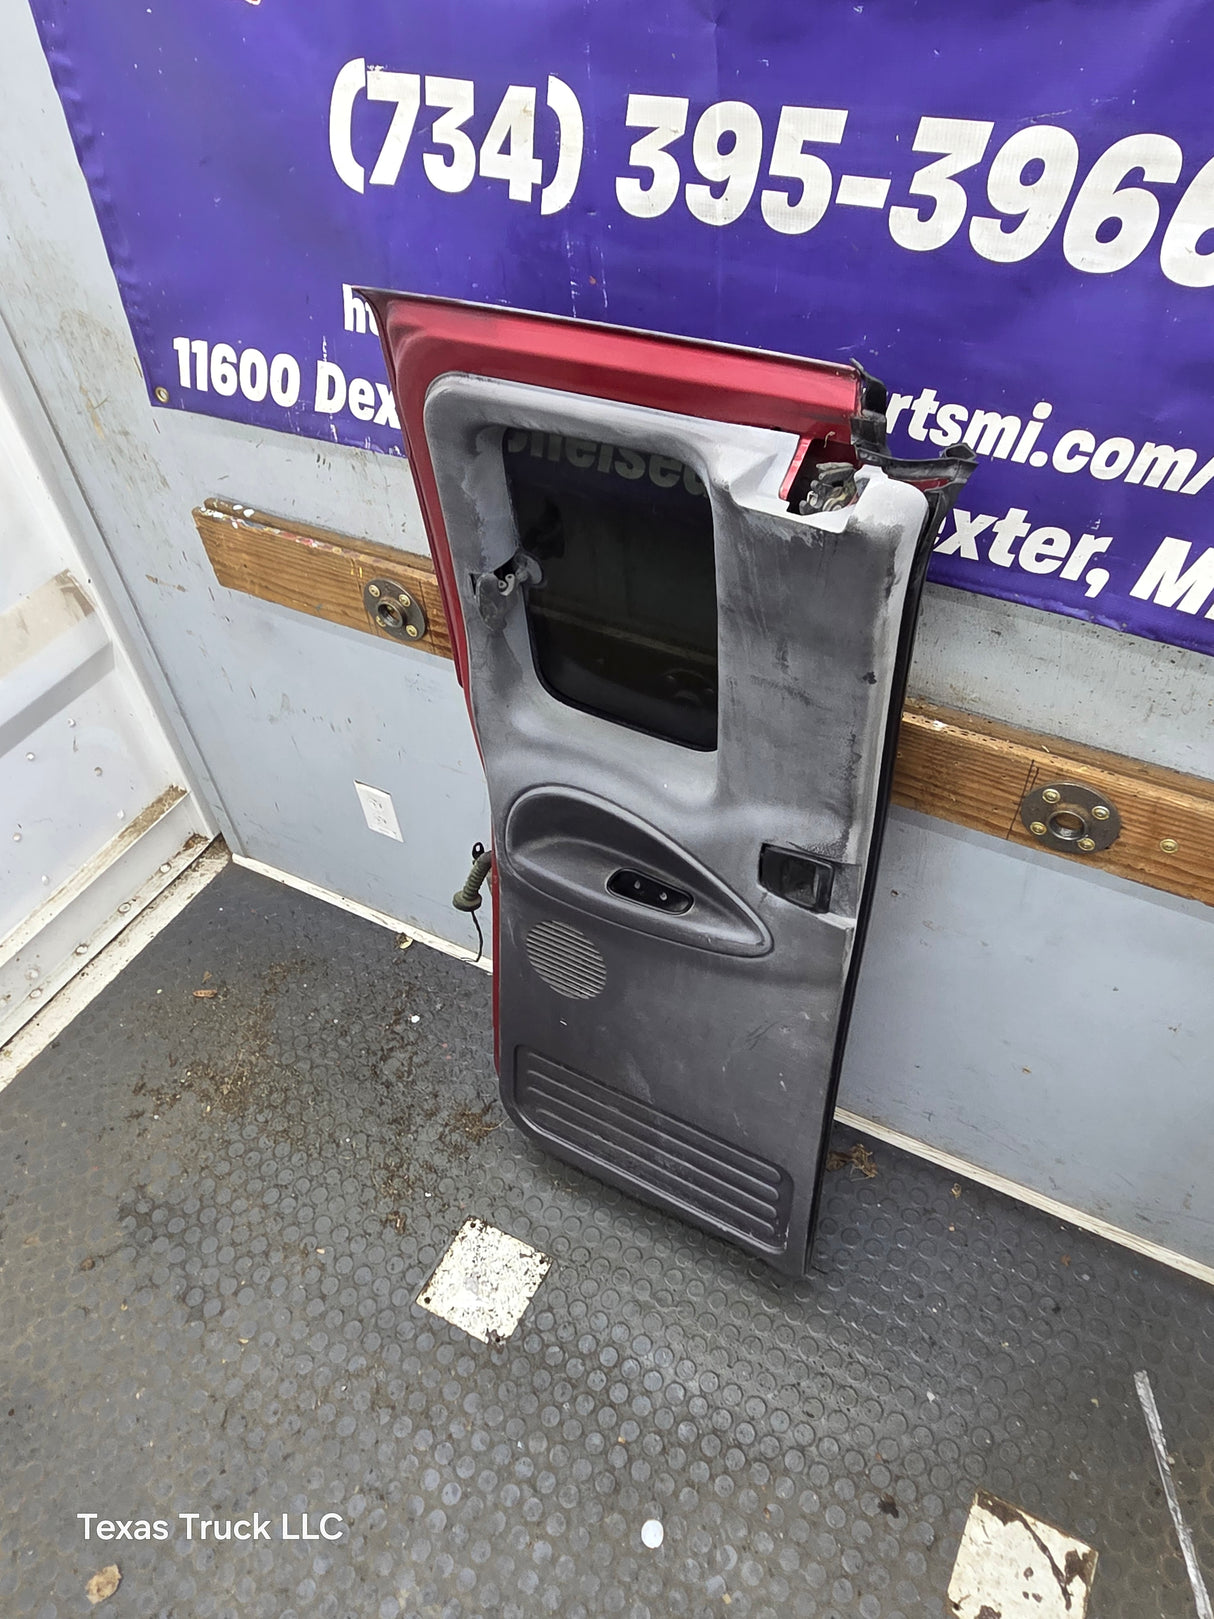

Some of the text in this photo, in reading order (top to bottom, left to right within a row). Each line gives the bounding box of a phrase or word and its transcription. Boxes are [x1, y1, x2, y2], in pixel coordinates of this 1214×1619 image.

[329, 57, 584, 216] (734)
[173, 336, 301, 408] 11600
[933, 507, 1114, 598] xter,
[1129, 536, 1214, 621] M
